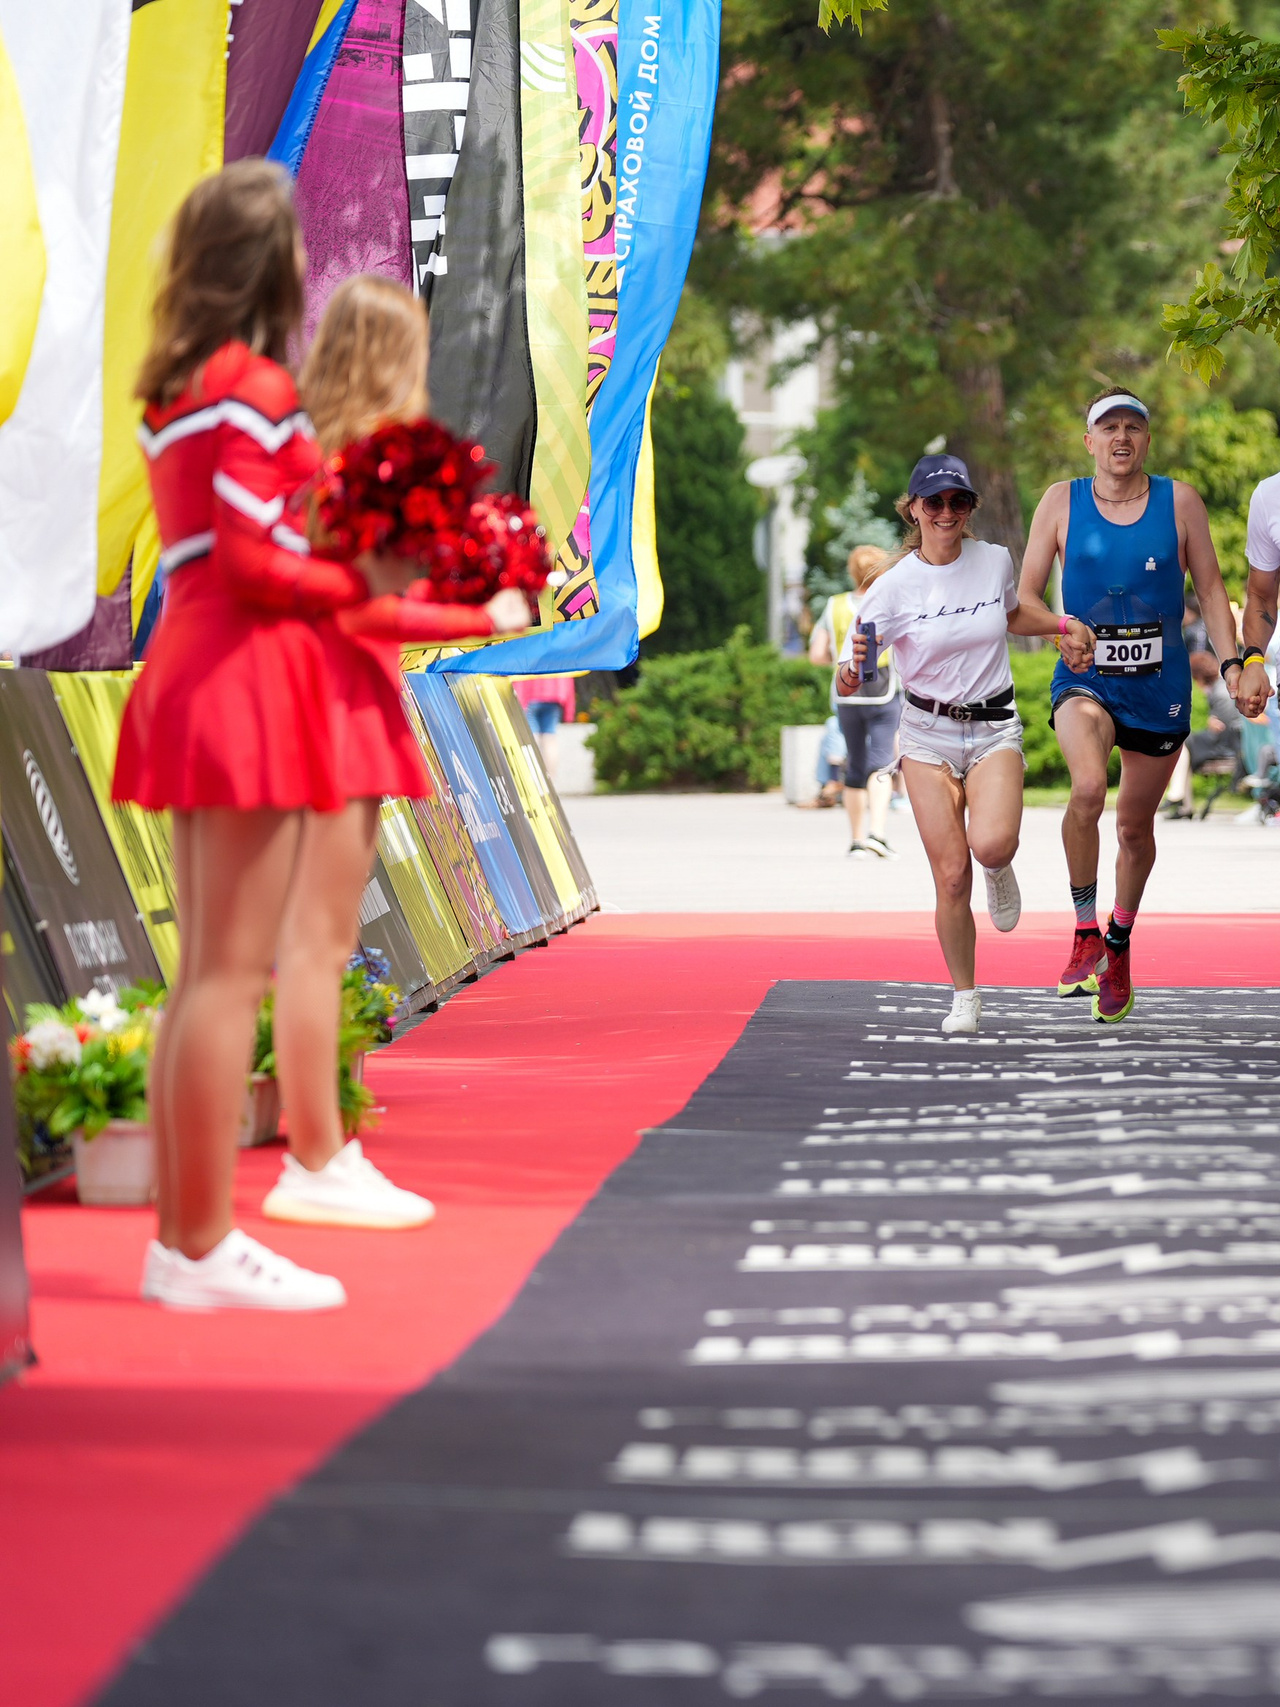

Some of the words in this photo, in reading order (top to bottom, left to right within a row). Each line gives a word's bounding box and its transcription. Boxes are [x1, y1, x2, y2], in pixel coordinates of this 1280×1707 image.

[614, 90, 653, 262] СТРАХОВОЙ
[637, 15, 662, 84] ДОМ
[1106, 643, 1152, 662] 2007
